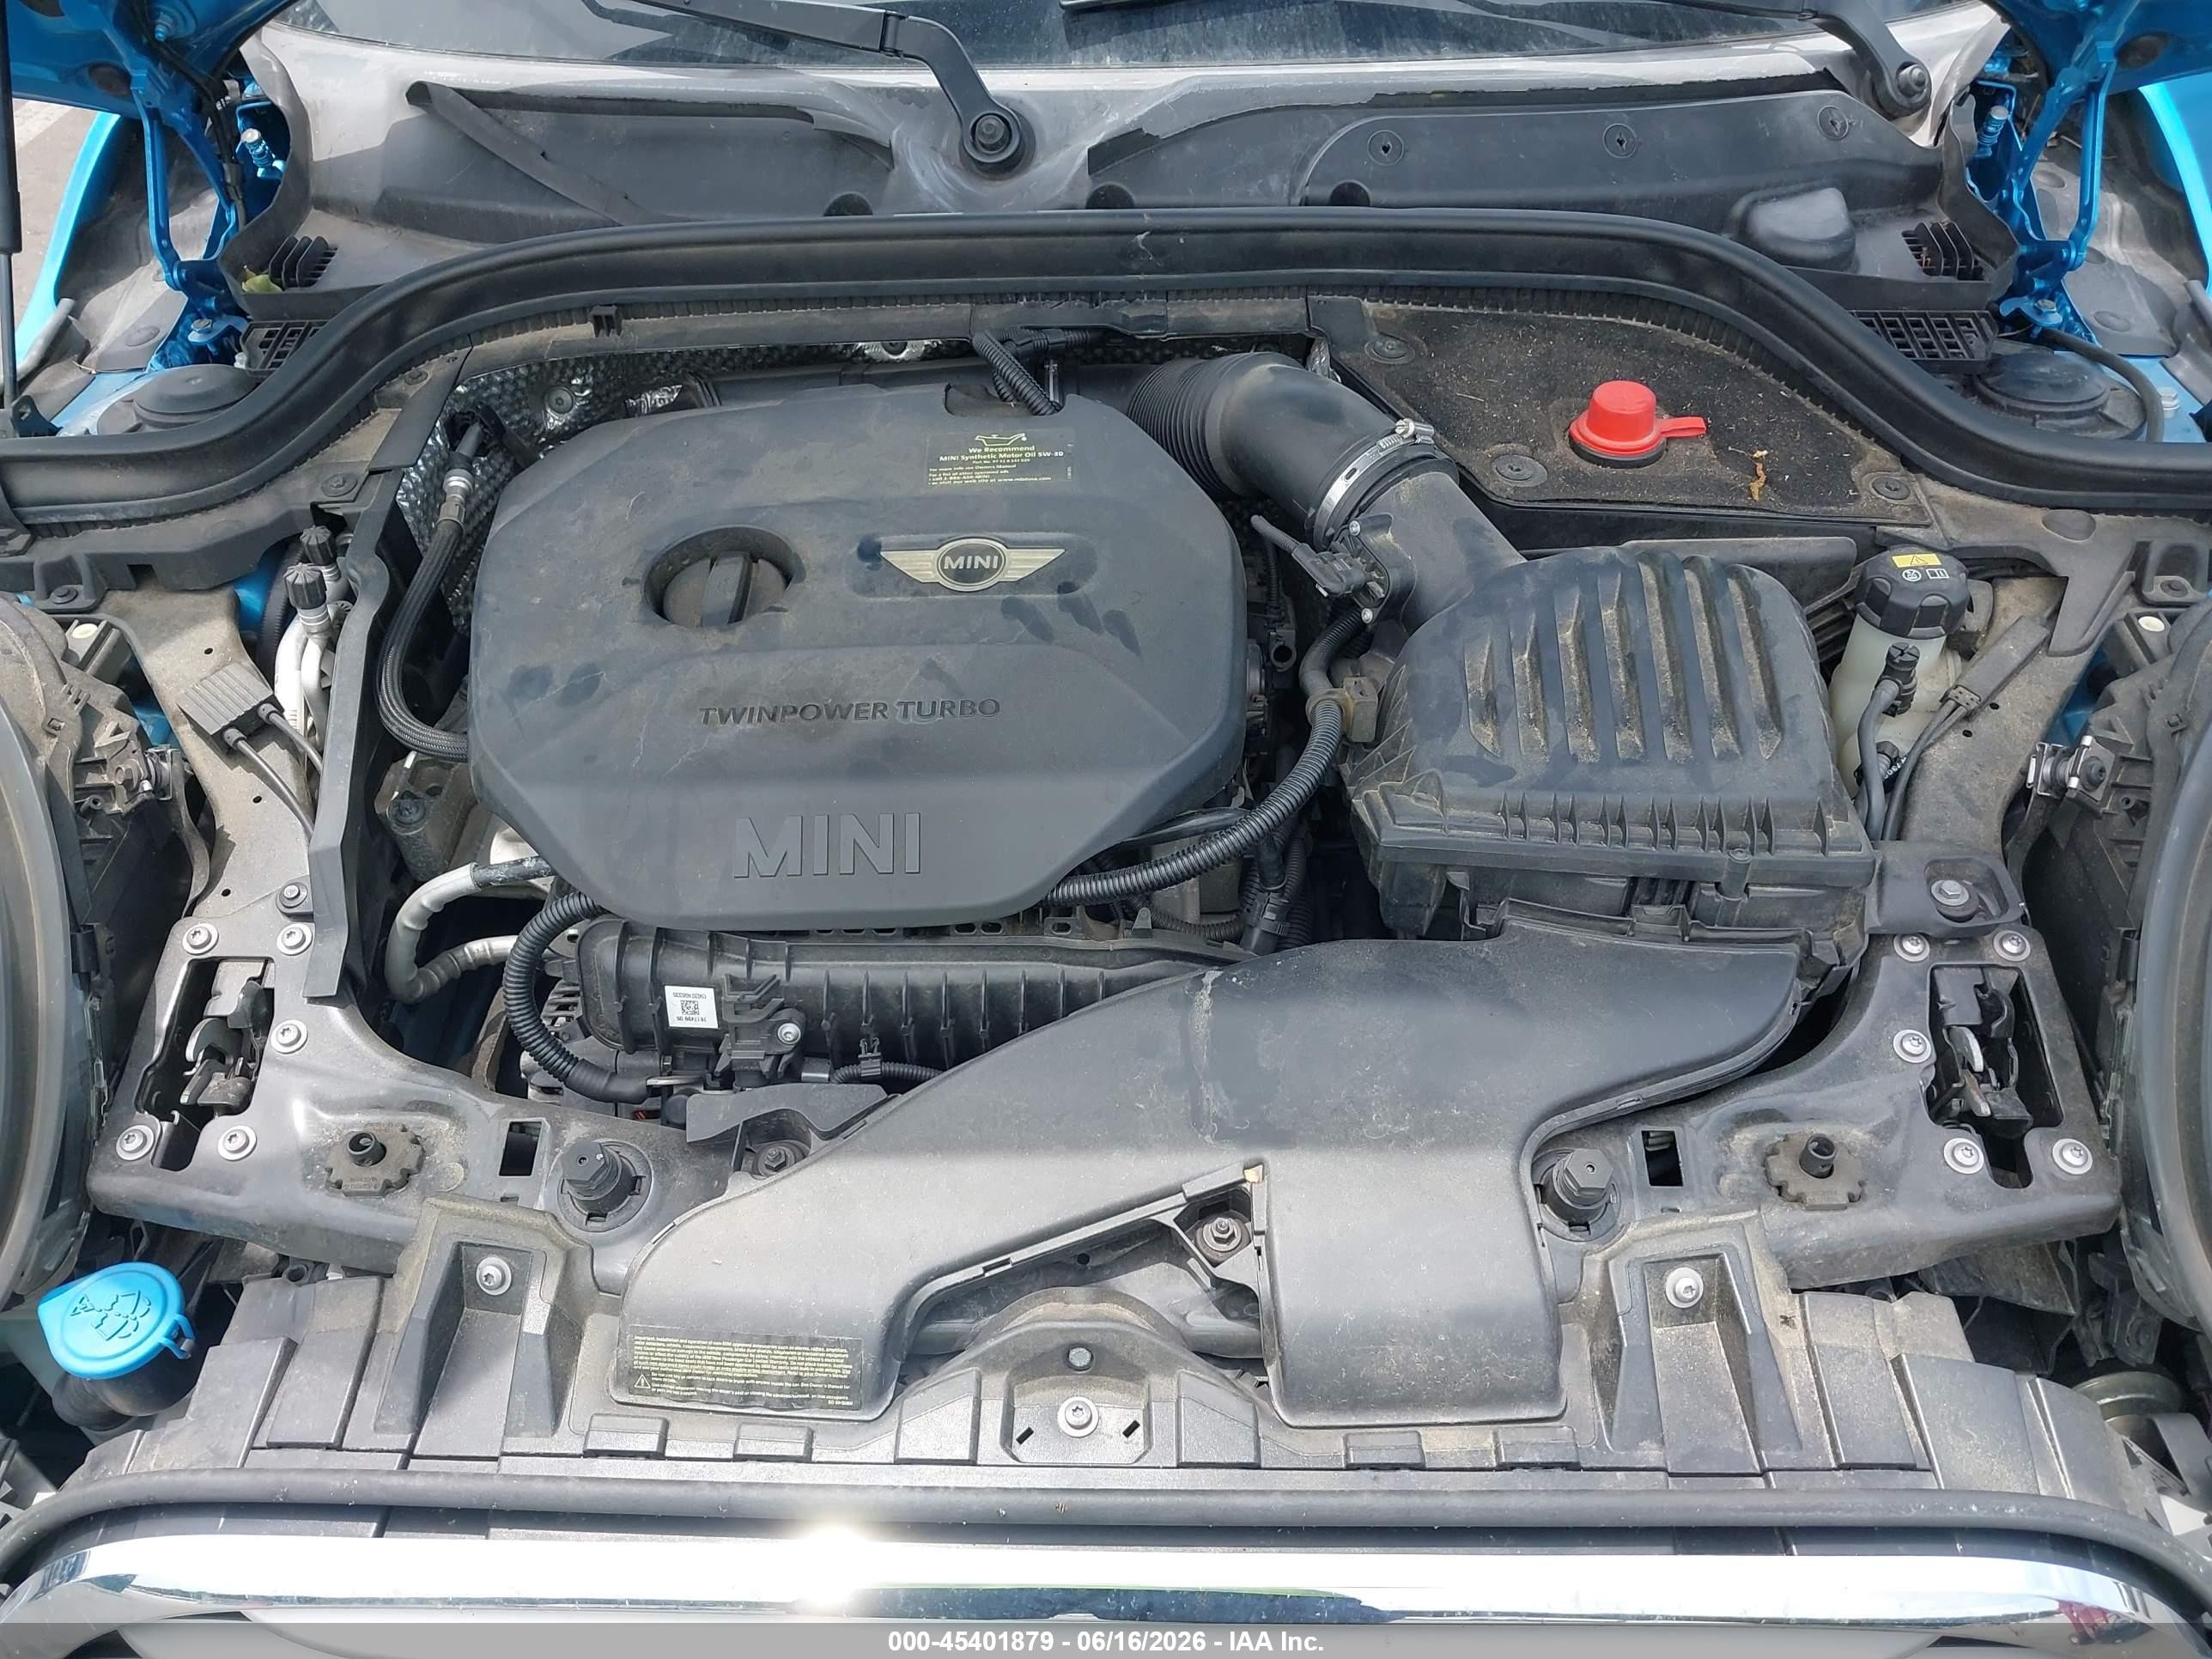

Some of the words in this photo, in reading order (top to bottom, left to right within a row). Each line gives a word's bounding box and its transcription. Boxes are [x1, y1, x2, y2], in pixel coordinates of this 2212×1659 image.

[961, 453, 997, 461] Synthetic
[943, 555, 999, 570] MINI
[699, 701, 888, 726] TWINPOWER
[896, 698, 1001, 720] TURBO
[734, 812, 921, 878] MINI
